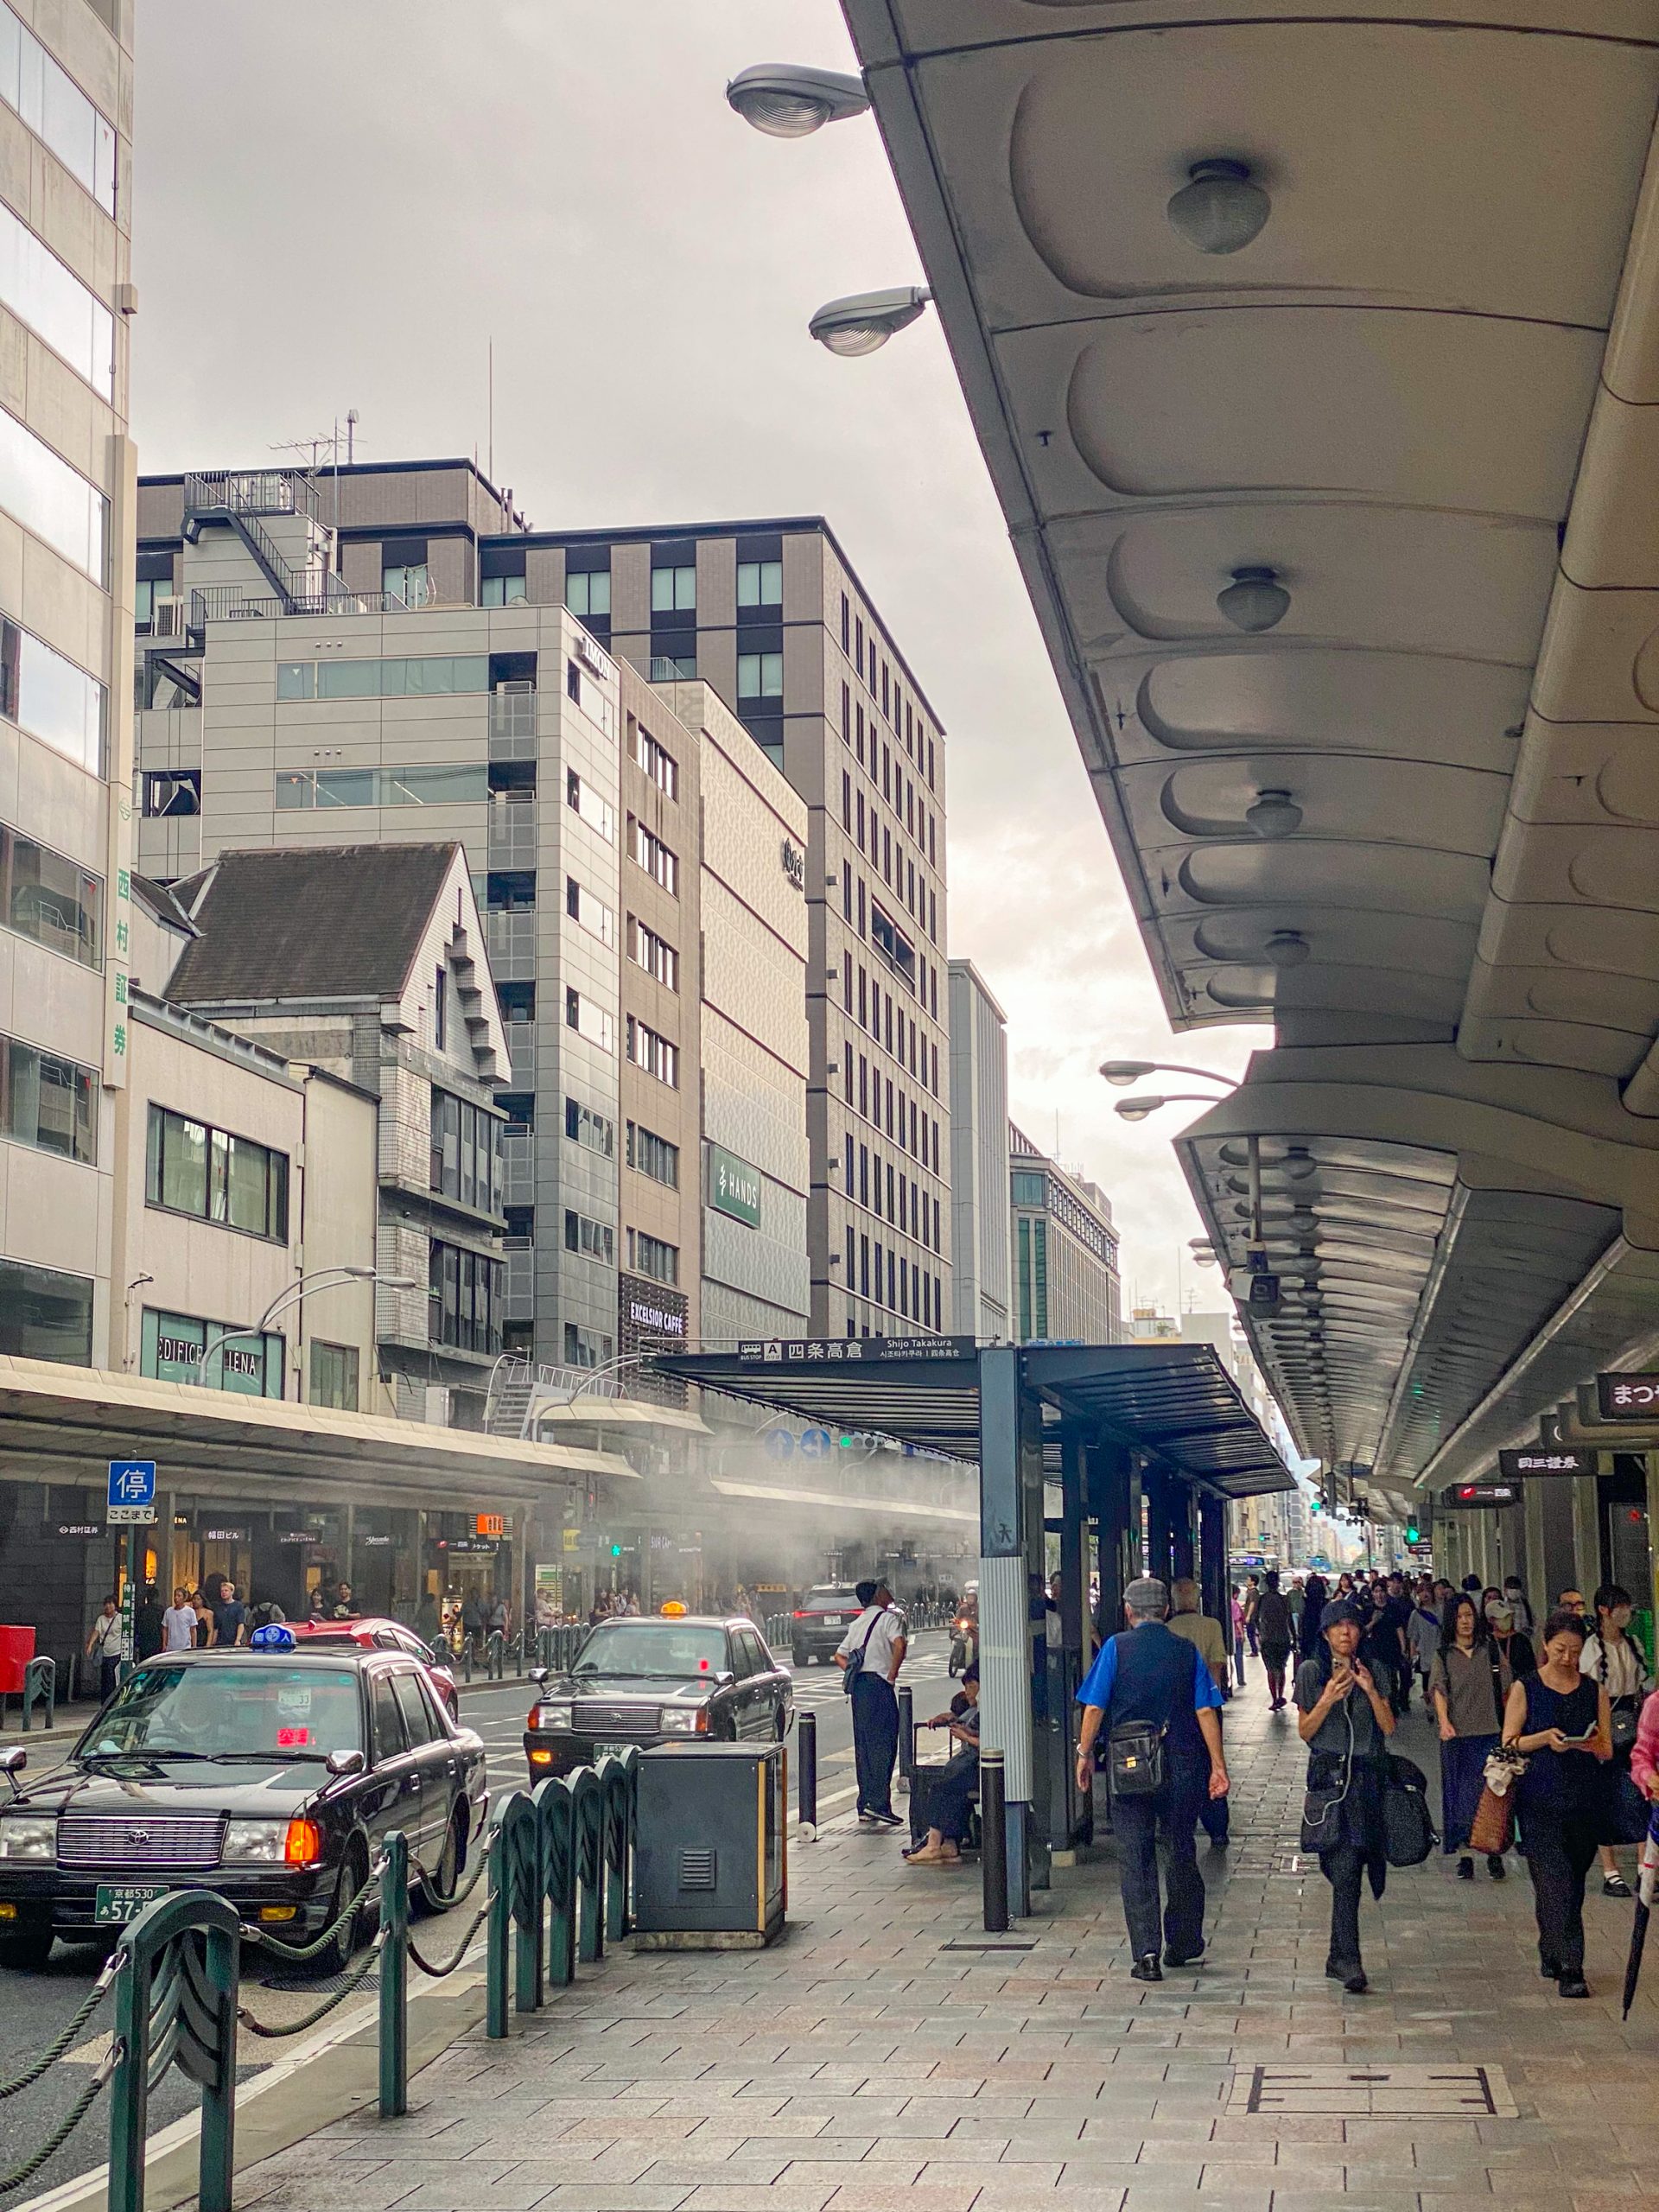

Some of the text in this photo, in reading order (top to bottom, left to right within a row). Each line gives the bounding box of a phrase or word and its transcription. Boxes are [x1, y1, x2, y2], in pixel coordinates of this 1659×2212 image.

[114, 868, 130, 1056] 西村証券
[729, 1172, 757, 1209] HANDS
[631, 1301, 663, 1328] EXCELSIOR
[768, 1344, 778, 1354] A
[789, 1341, 862, 1359] 四条高倉
[887, 1339, 909, 1349] Shijo
[1614, 1384, 1659, 1404] まつ
[116, 1469, 147, 1499] 停
[109, 1510, 152, 1520] ここまで
